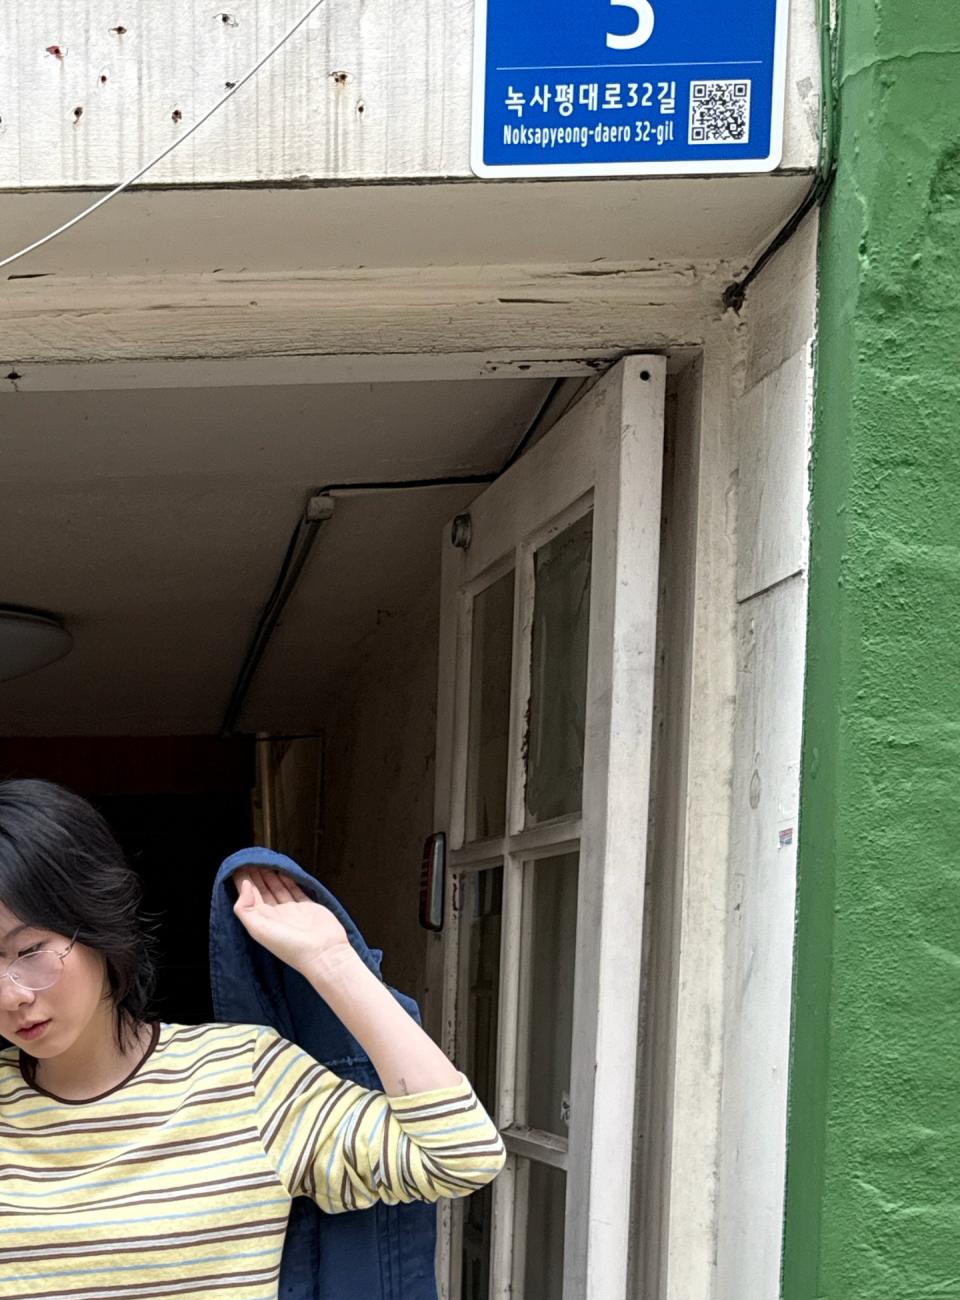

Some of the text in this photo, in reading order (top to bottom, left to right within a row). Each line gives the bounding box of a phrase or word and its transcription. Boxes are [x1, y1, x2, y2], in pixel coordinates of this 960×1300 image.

[504, 81, 676, 118] 녹사평대로32길
[503, 120, 674, 148] Noksapyeong-daero 32-gil
